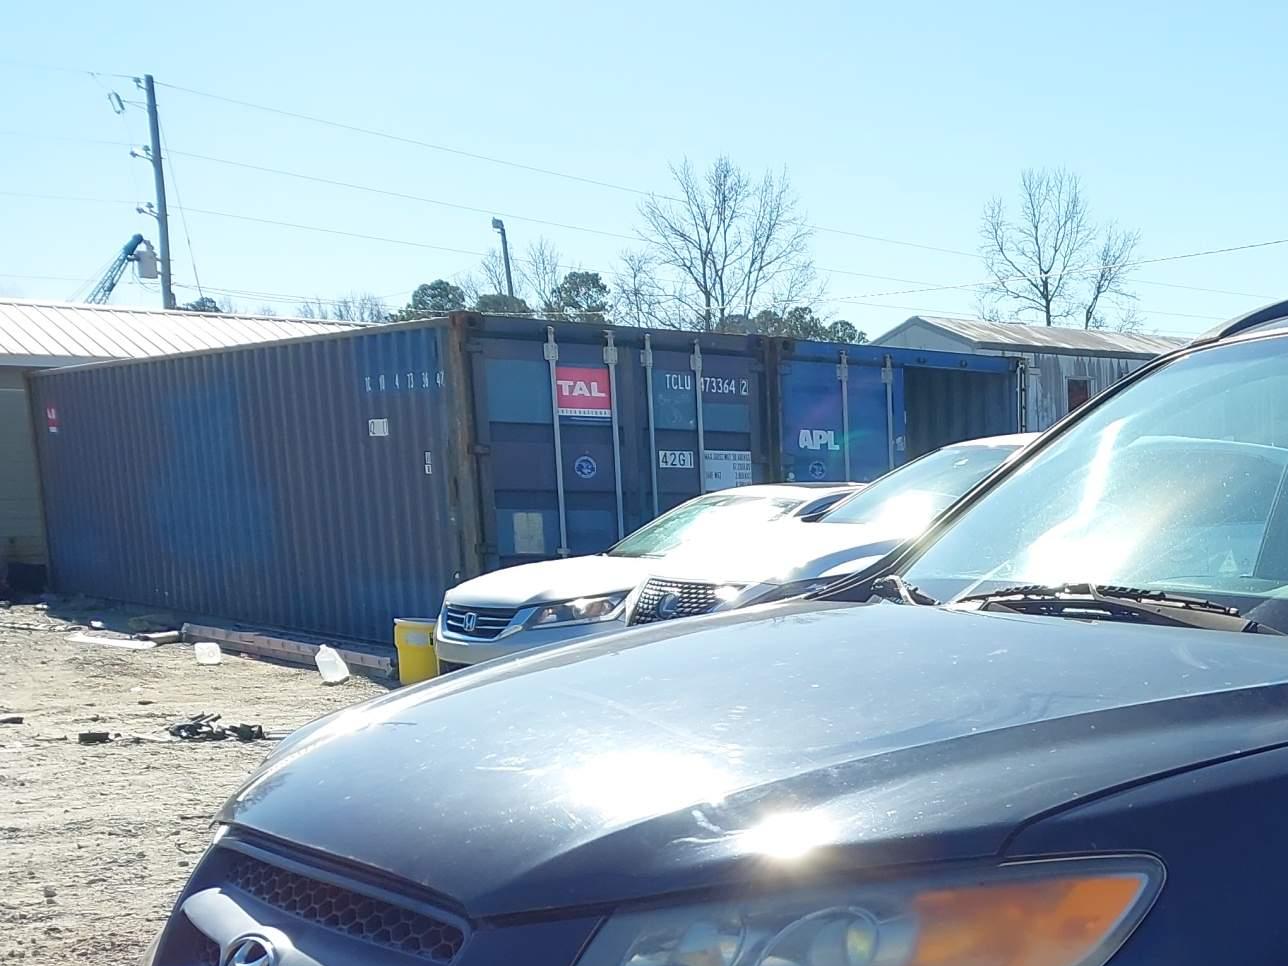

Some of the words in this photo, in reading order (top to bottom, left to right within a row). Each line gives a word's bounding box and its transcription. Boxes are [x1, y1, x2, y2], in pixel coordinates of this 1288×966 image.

[556, 380, 607, 397] TAL
[665, 374, 692, 390] TCLU
[799, 429, 840, 451] APL
[661, 452, 693, 467] 42G1
